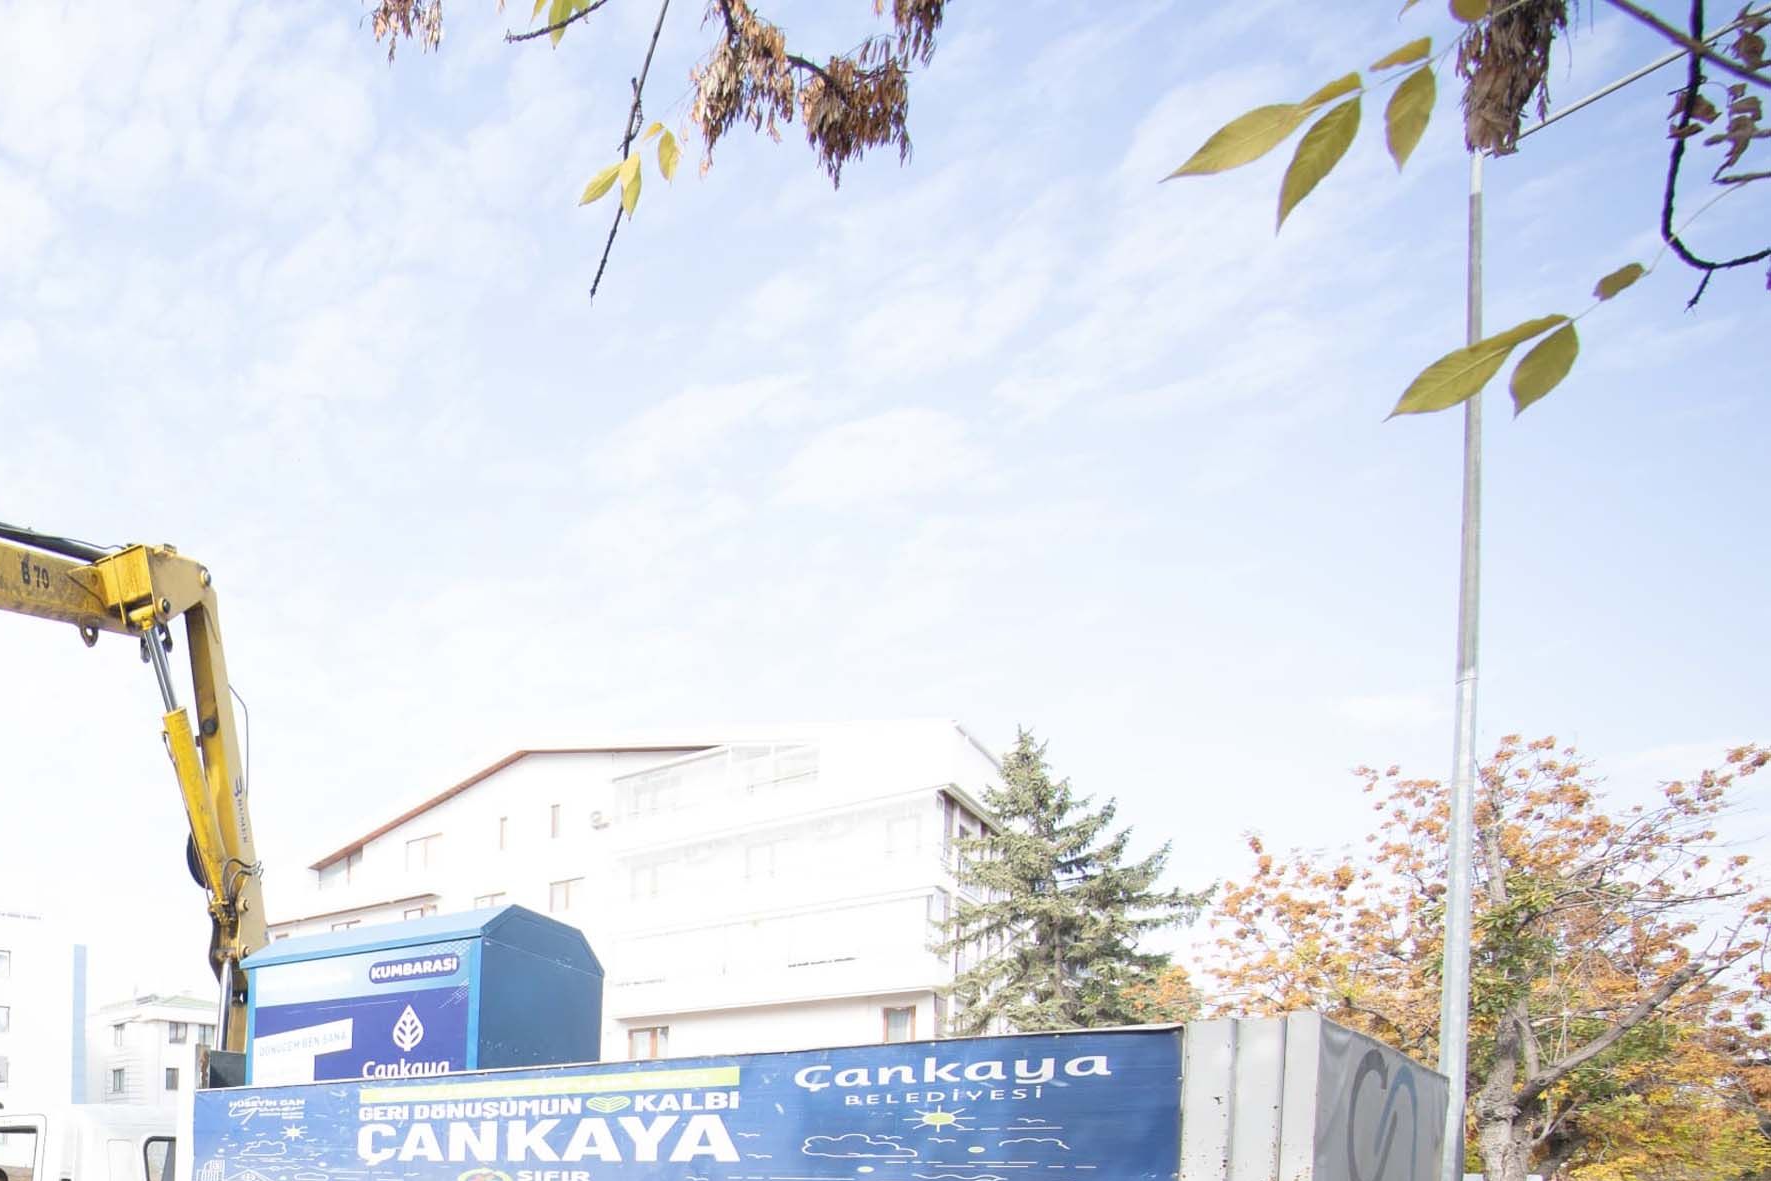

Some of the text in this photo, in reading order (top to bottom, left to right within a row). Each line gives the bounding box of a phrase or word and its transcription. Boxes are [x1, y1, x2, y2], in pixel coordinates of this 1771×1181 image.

[370, 957, 458, 981] KUMBARASI
[794, 1055, 1113, 1092] Çankaya
[844, 1085, 1043, 1107] BELEDİYESİ
[357, 1113, 741, 1167] ÇANKAYA
